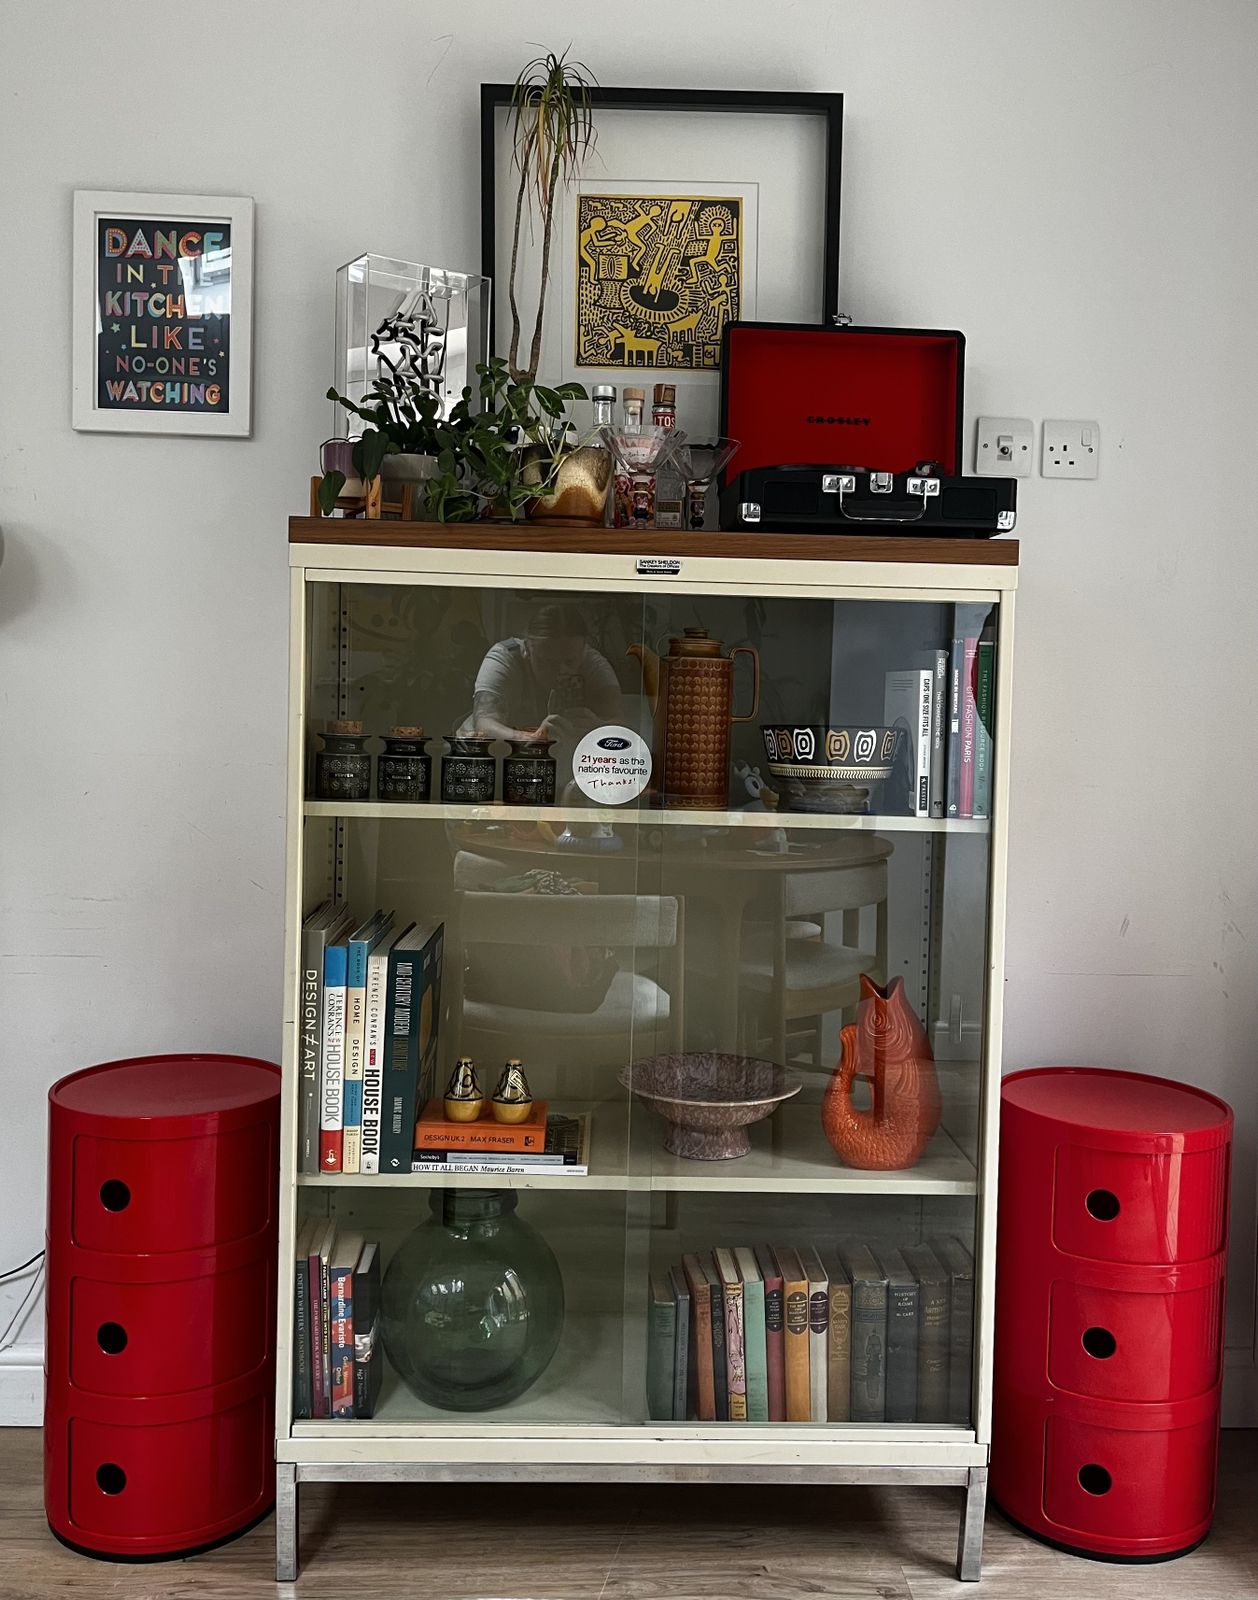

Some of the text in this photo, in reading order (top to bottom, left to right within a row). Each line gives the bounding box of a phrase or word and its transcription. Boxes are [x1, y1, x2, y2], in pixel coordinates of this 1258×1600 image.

[105, 227, 223, 262] DANCE
[116, 263, 144, 284] IN
[130, 325, 205, 350] LIKE
[116, 355, 217, 376] NO-ONE'S
[105, 380, 222, 406] WATCHING
[806, 415, 870, 426] CROSLEY
[963, 686, 973, 763] CITY FASHION PARIS
[604, 740, 624, 748] Ford
[578, 765, 648, 776] nation's favourite
[581, 754, 645, 766] 21 years as the
[587, 777, 636, 789] Thanks!
[305, 969, 317, 1030] DESIGN
[352, 997, 360, 1025] HOME
[369, 966, 379, 1046] TERENCE CONRAN'S
[393, 962, 413, 1036] MID-CENTURY MODERN
[327, 993, 335, 1037] CONRAN'S
[334, 993, 343, 1035] TERENCE
[303, 1048, 316, 1081] ART
[351, 1039, 359, 1075] DESIGN
[324, 1044, 341, 1123] HOUSE BOOK
[362, 1069, 380, 1156] HOUSE BOOK
[424, 1134, 450, 1142] DESIGN
[488, 1136, 515, 1144] FRASER
[413, 1163, 479, 1172] HOW IT ALL BEGAN
[480, 1165, 505, 1173] Maurice
[337, 1276, 346, 1348] Bernardine Evaristo
